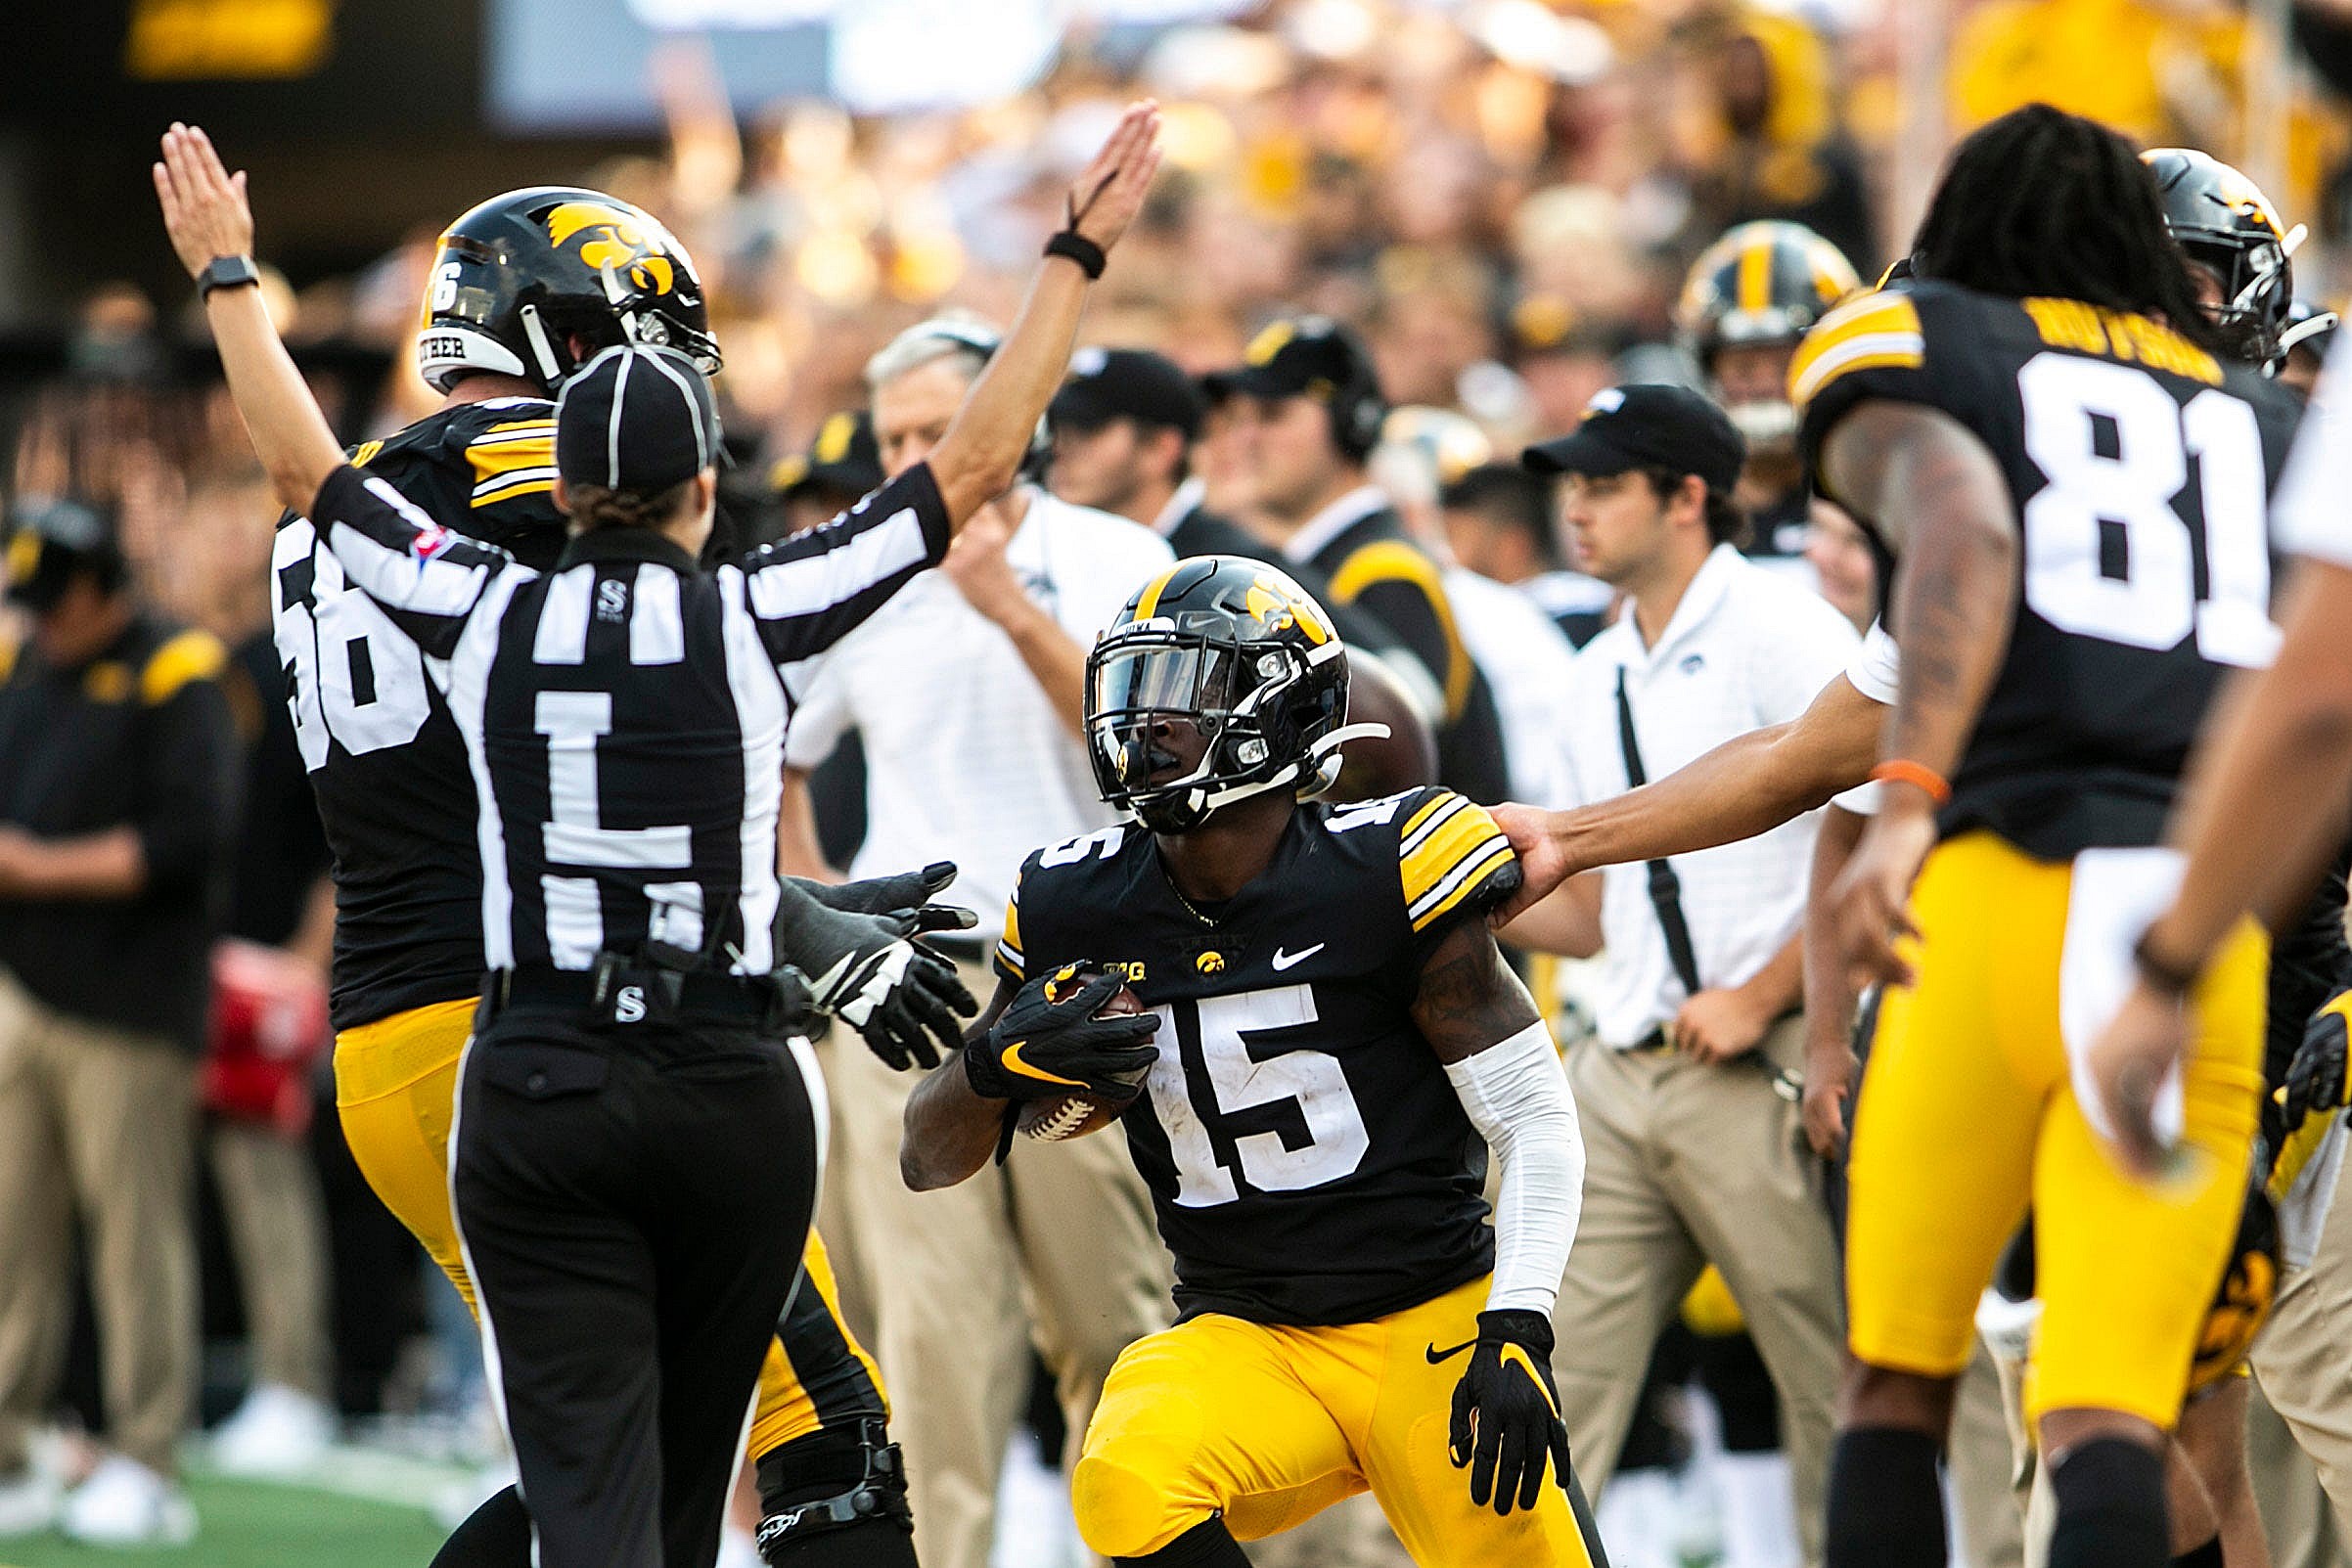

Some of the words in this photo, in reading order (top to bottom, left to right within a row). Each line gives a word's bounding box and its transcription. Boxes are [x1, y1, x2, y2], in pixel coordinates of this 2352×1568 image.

[432, 262, 462, 311] 6
[2018, 351, 2284, 669] 81
[534, 691, 692, 868] L
[615, 986, 647, 1022] S
[1147, 983, 1370, 1207] 15
